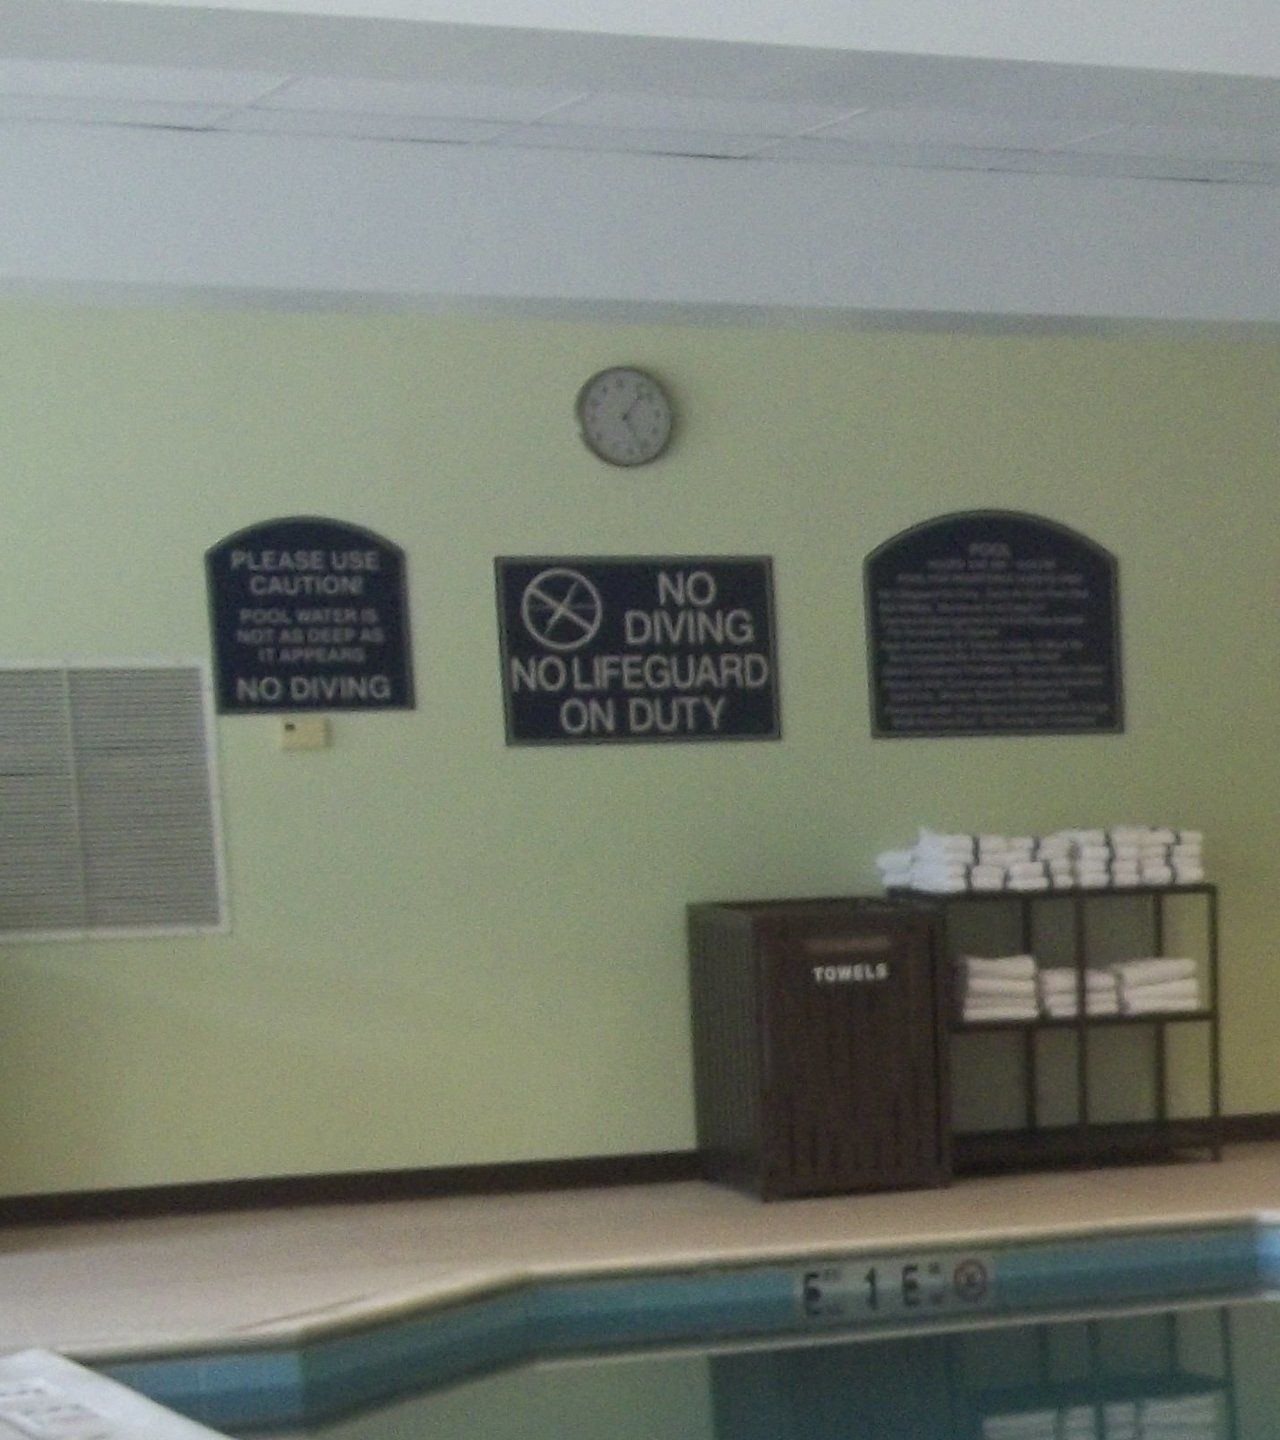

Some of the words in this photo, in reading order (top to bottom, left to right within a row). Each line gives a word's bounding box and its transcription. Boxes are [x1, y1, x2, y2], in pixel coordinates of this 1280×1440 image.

[231, 551, 323, 571] PLEASE
[332, 550, 379, 571] USE
[657, 570, 717, 606] NO
[240, 608, 291, 623] POOL
[625, 608, 754, 645] DIVING
[237, 628, 274, 643] NOT
[308, 627, 353, 643] DEEP
[279, 647, 364, 662] APPEARS
[511, 655, 567, 692] NO
[573, 653, 769, 690] LIFEGUARD
[237, 676, 281, 700] NO
[291, 674, 391, 700] DIVING
[560, 697, 616, 733] ON
[629, 697, 726, 733] DUTY
[812, 963, 889, 983] TOWELS
